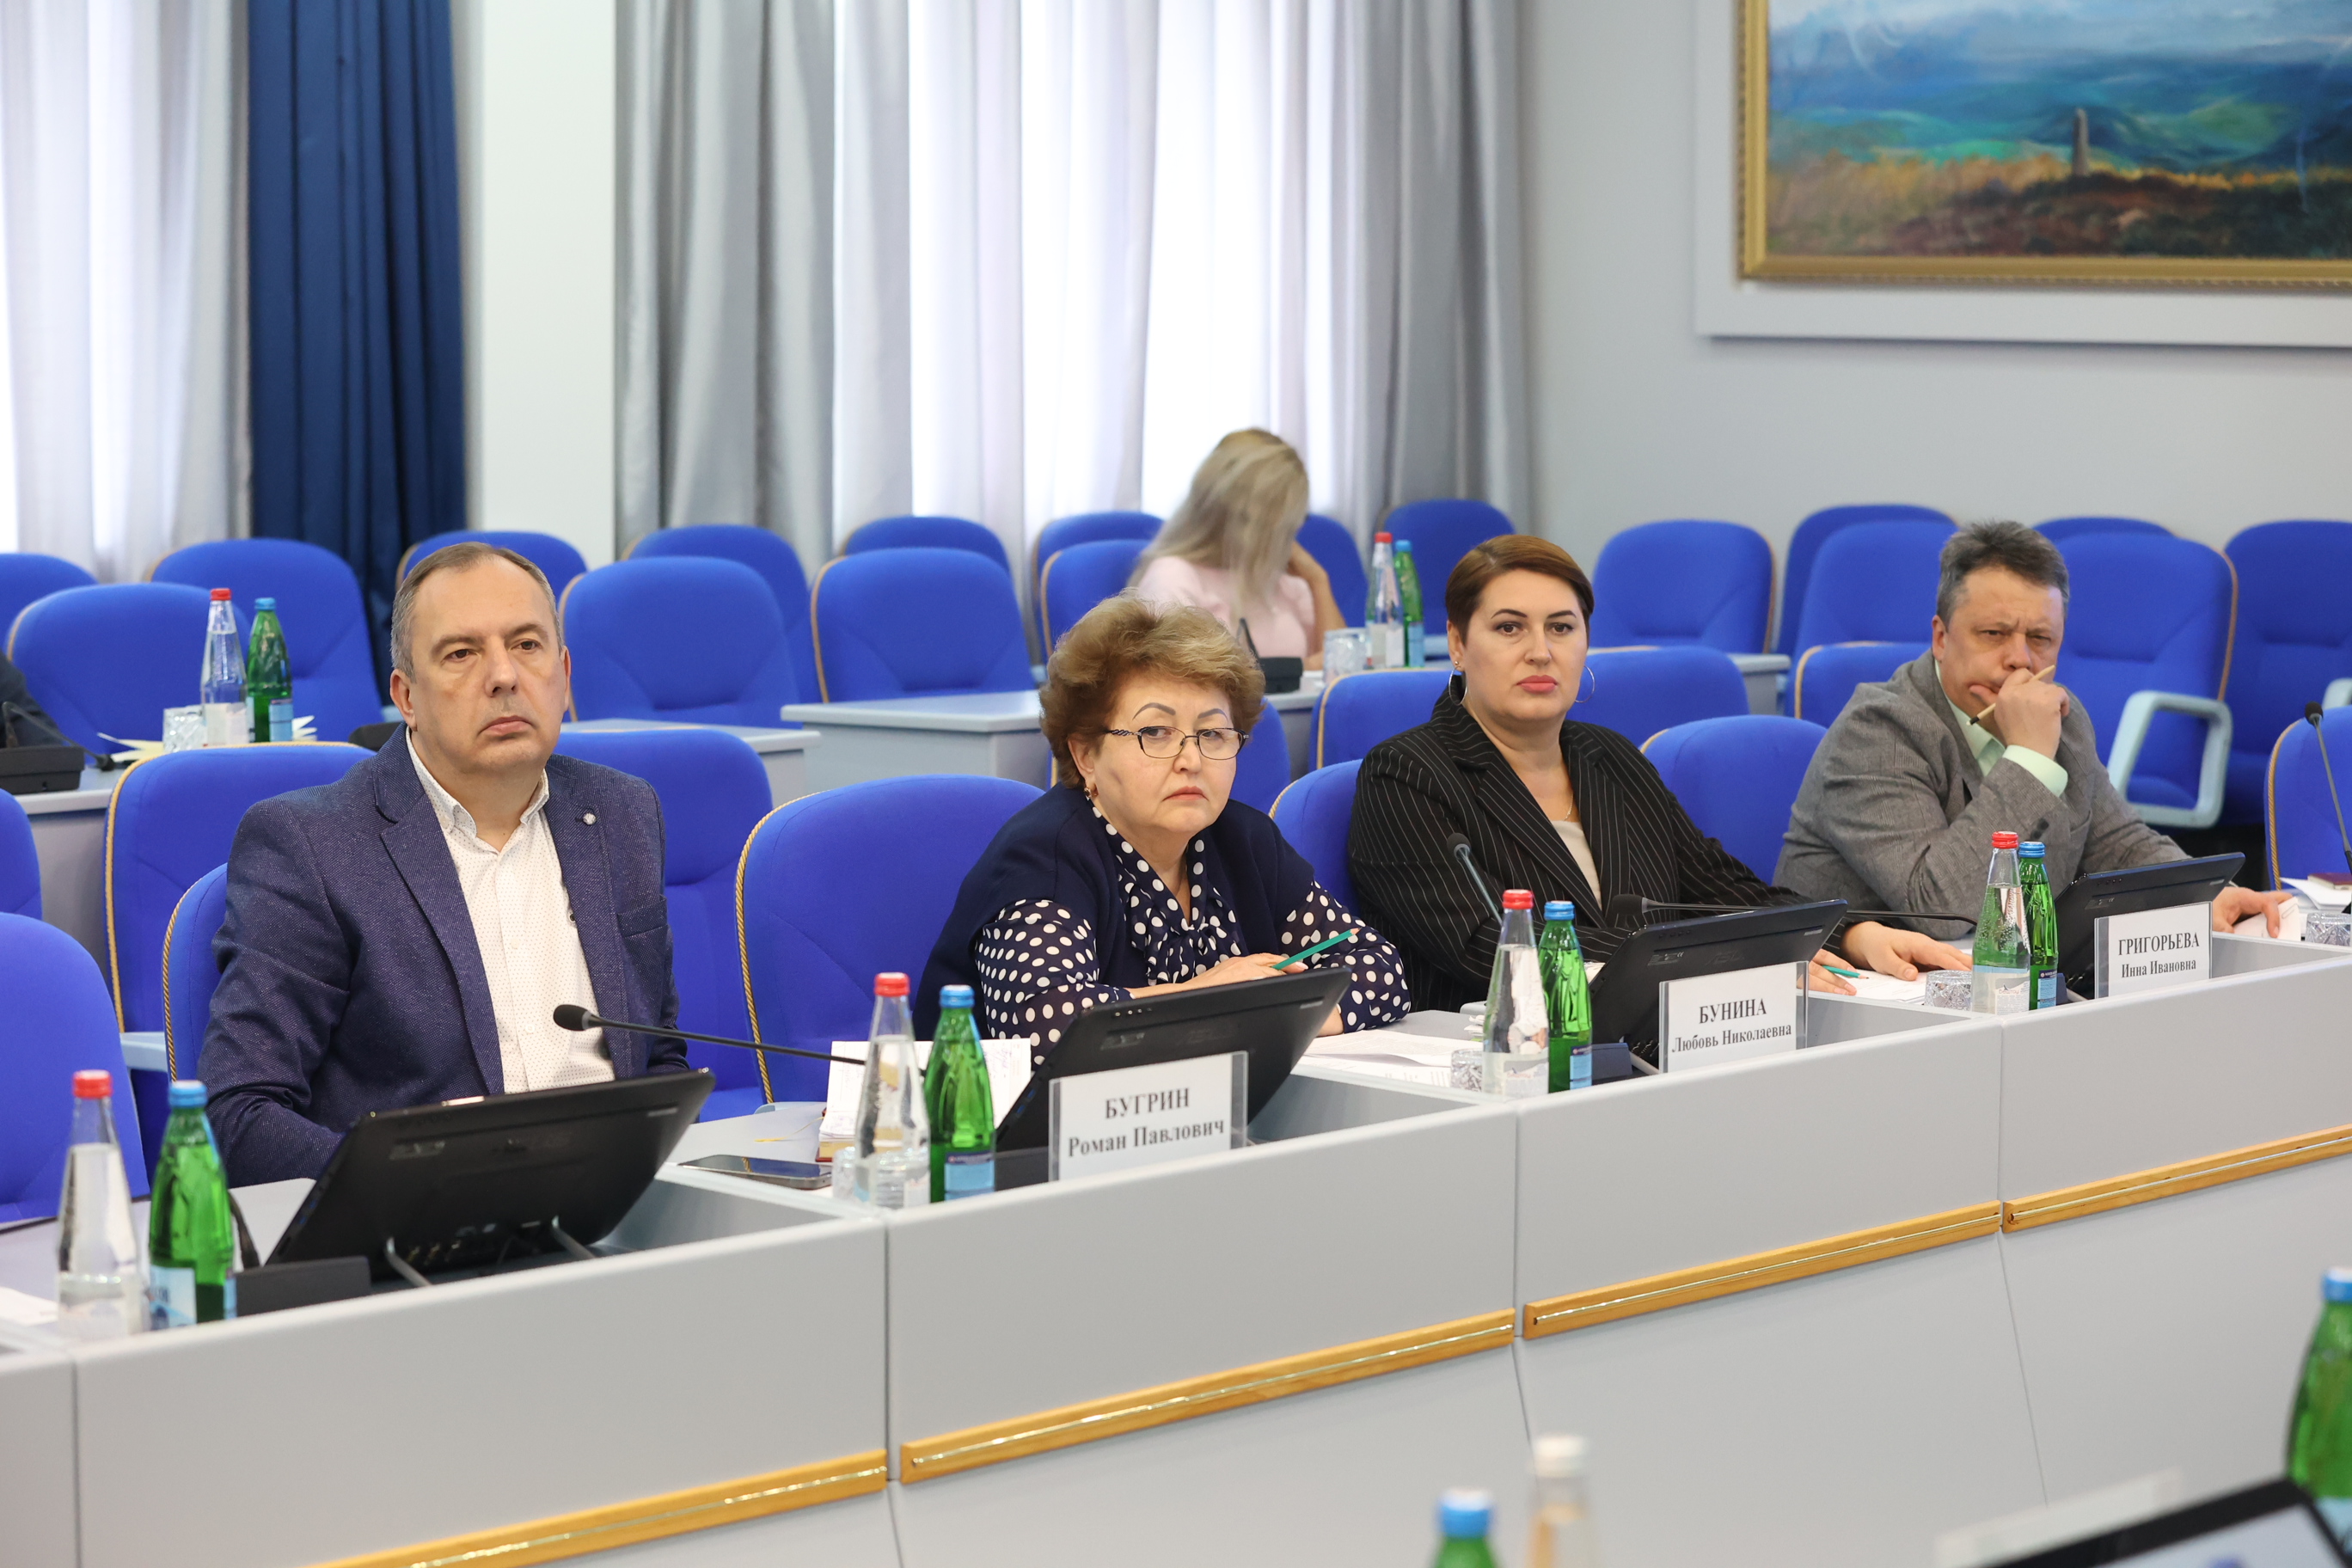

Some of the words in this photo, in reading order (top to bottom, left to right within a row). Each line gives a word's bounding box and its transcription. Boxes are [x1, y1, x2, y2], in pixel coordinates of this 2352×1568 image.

[2118, 932, 2200, 956] ГРИГОРЬЕВА
[2121, 964, 2147, 978] Инна
[2150, 959, 2196, 975] Ивановна
[1699, 998, 1767, 1024] БУНИНА
[1671, 1034, 1718, 1053] Любовь
[1722, 1024, 1792, 1045] Николаевна
[1105, 1087, 1190, 1119] БУГРИН
[1068, 1135, 1126, 1157] Роман
[1133, 1119, 1225, 1148] Павлович
